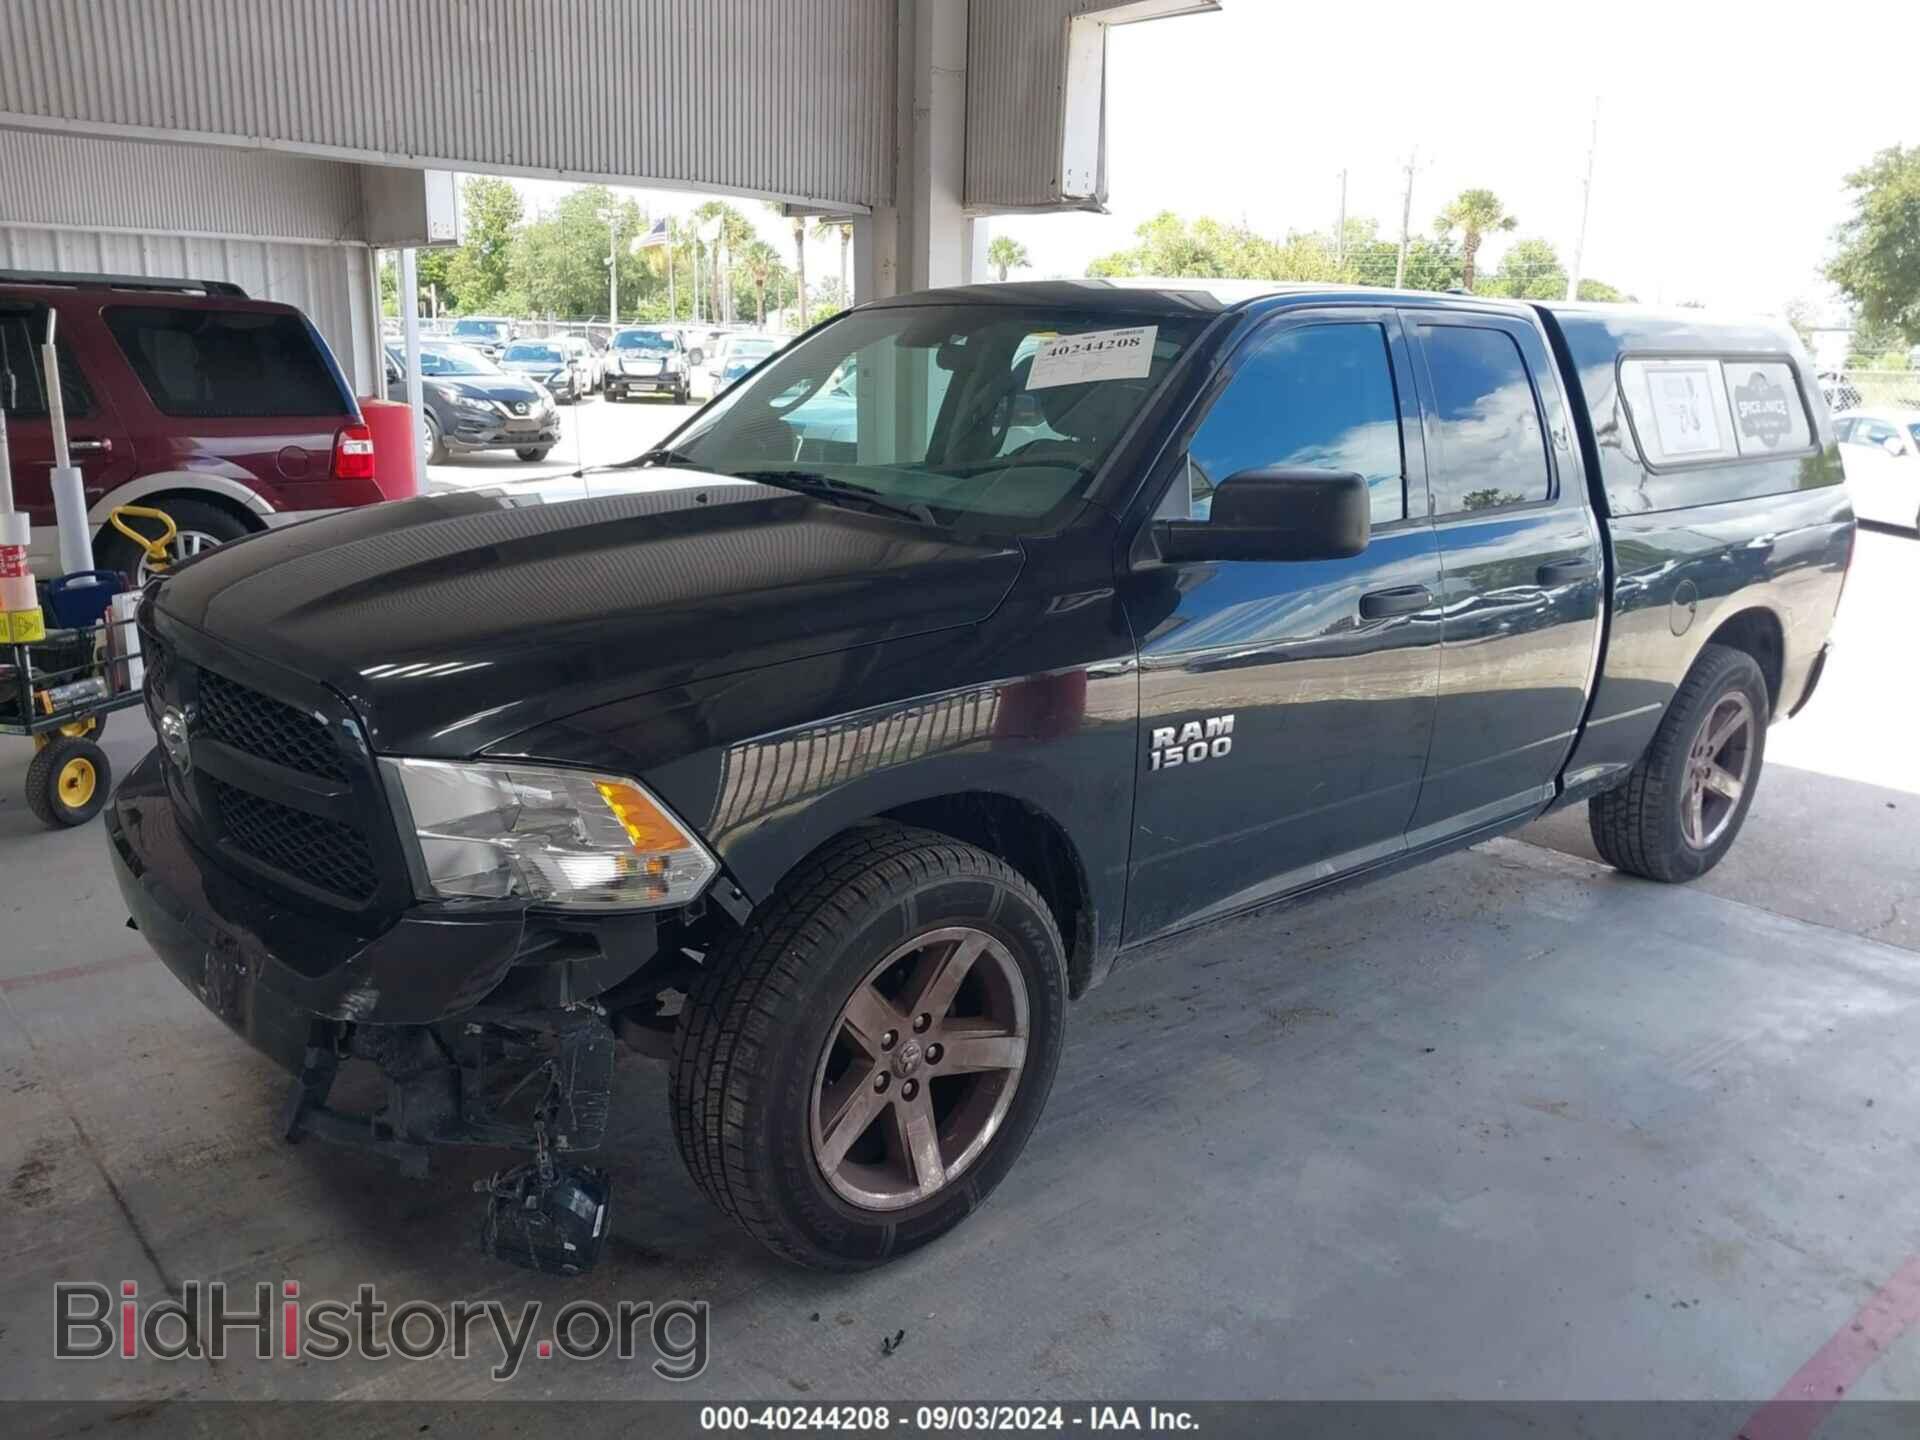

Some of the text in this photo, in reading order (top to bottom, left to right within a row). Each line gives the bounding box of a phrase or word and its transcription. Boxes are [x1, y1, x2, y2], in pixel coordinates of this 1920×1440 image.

[1047, 337, 1141, 357] 40244208
[1152, 714, 1235, 749] RAM
[1151, 736, 1232, 771] 1500
